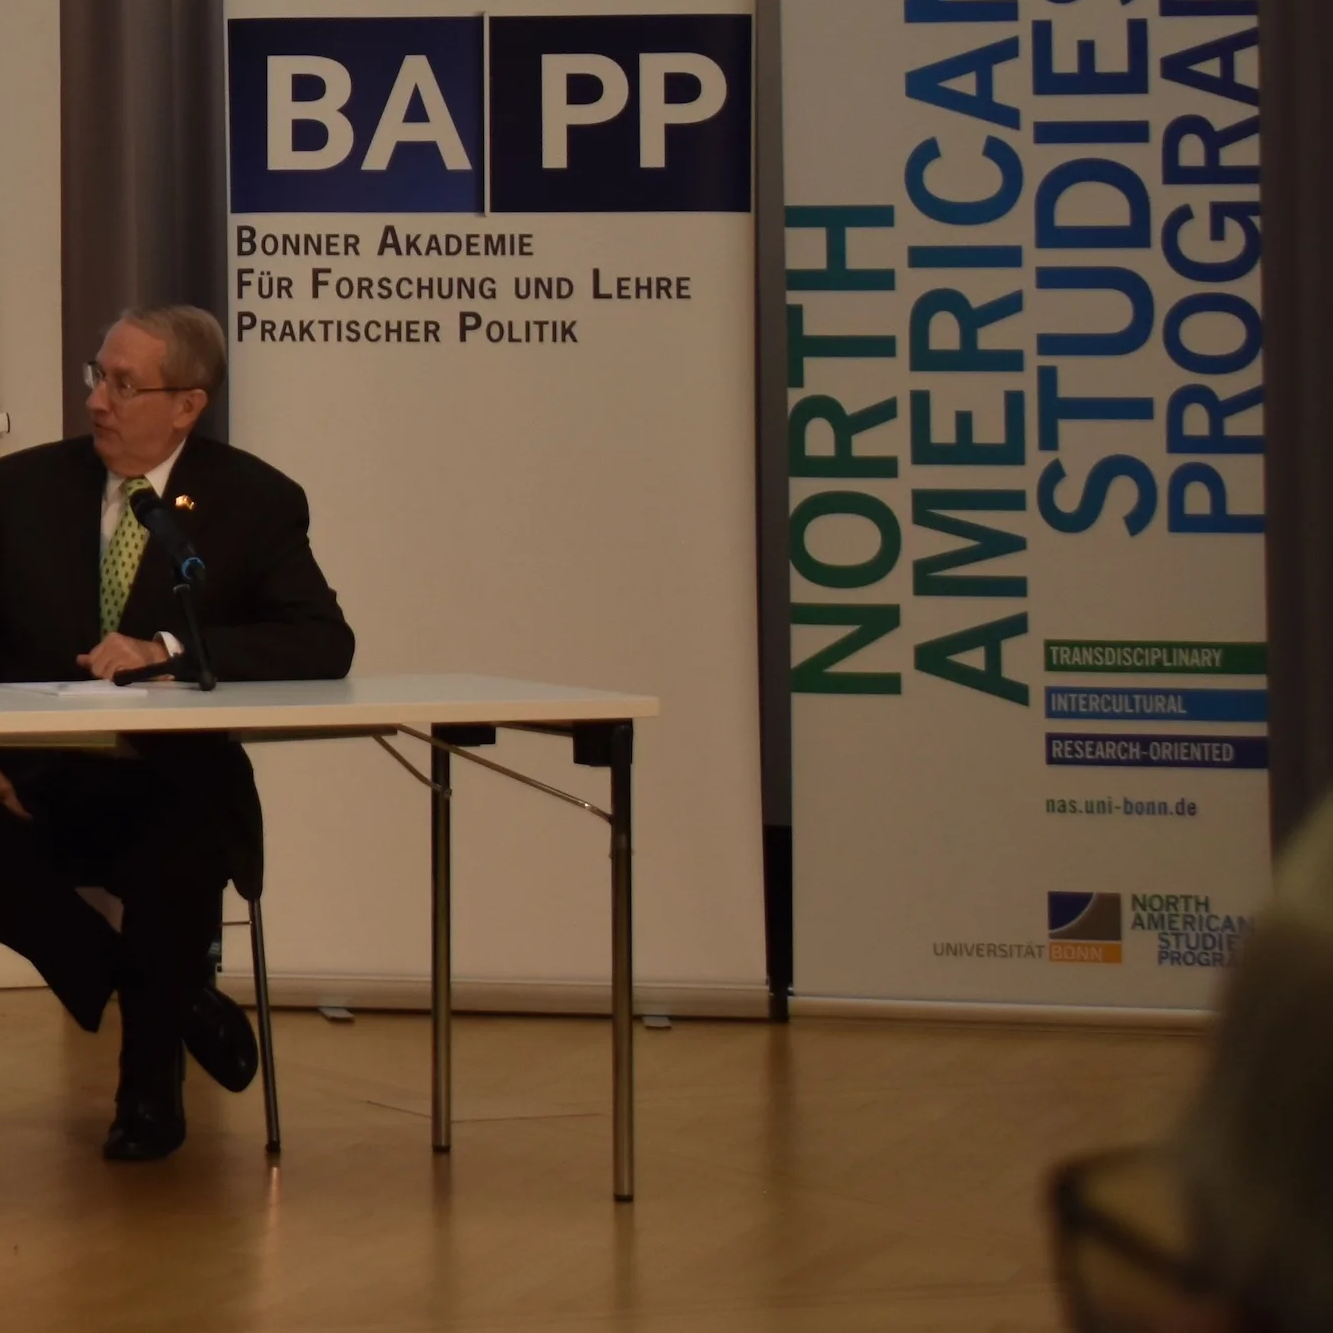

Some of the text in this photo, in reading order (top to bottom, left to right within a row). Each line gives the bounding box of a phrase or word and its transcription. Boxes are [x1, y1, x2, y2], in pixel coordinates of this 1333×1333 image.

[785, 205, 901, 694] NORTH
[1049, 646, 1222, 667] TRANSDISCIPLINARY
[1051, 693, 1188, 714] INTERCULTURAL
[1052, 740, 1235, 762] RESEARCH-ORIENTED
[1046, 797, 1196, 816] nas.uni-bonn.de
[1131, 894, 1210, 913] NORTH
[933, 940, 1102, 962] UNIVERSITÄT BONN
[1158, 933, 1240, 952] STUDIE
